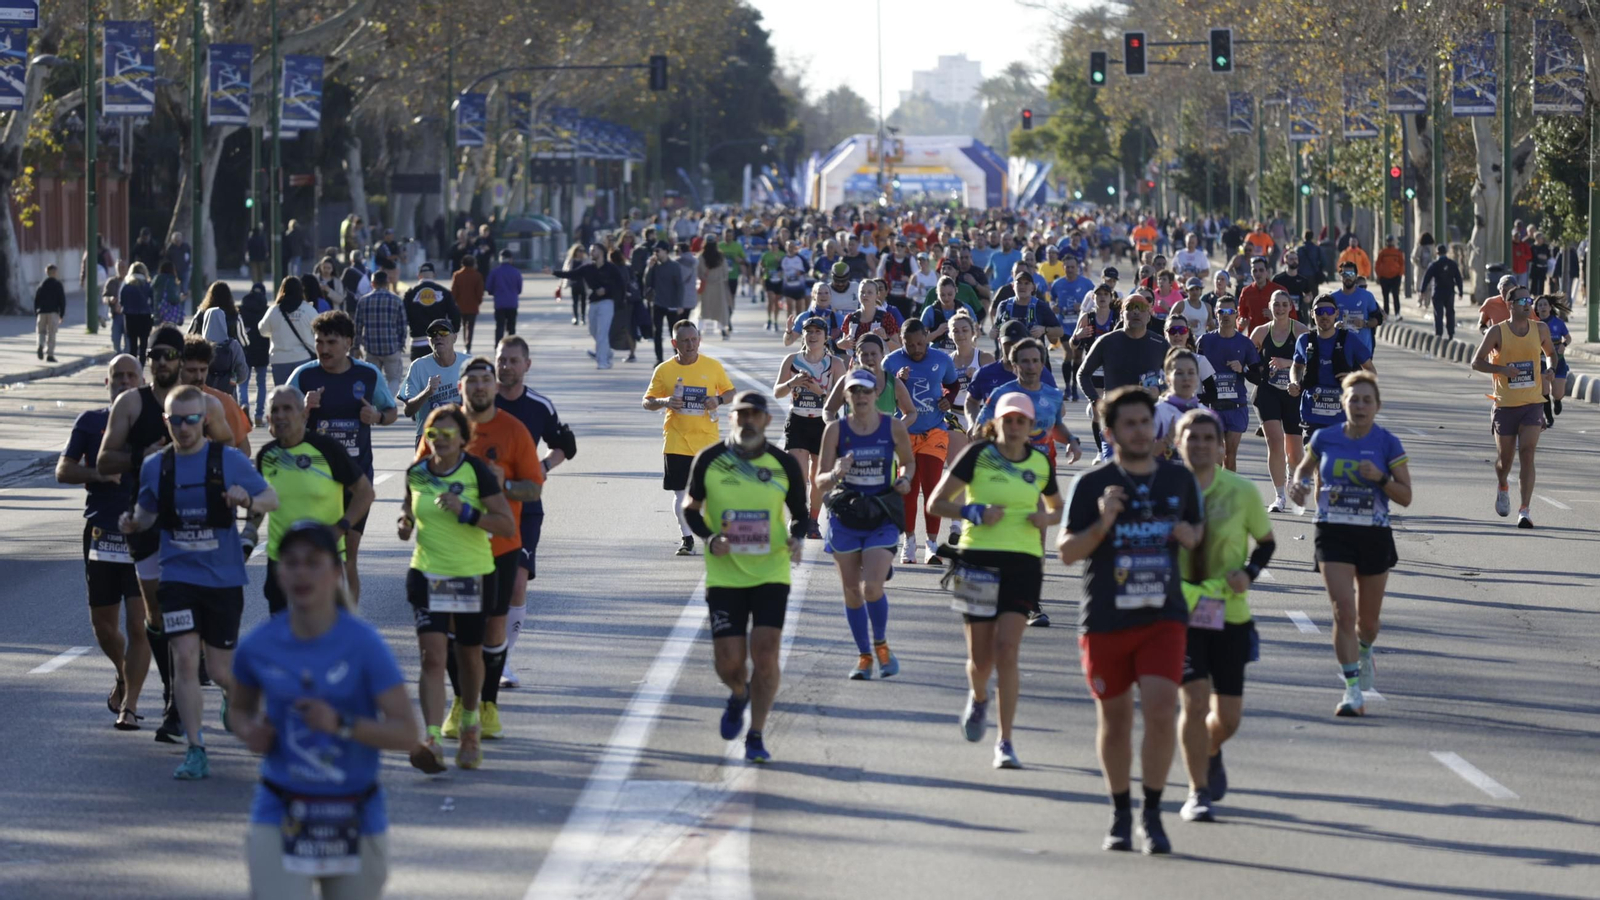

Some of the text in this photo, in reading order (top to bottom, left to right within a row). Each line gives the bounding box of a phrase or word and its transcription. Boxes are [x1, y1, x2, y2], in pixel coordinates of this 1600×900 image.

[798, 400, 817, 408] PARIS
[1314, 401, 1341, 409] MATHIEU
[174, 529, 214, 540] SINCLAIR
[98, 541, 129, 552] SERGIO
